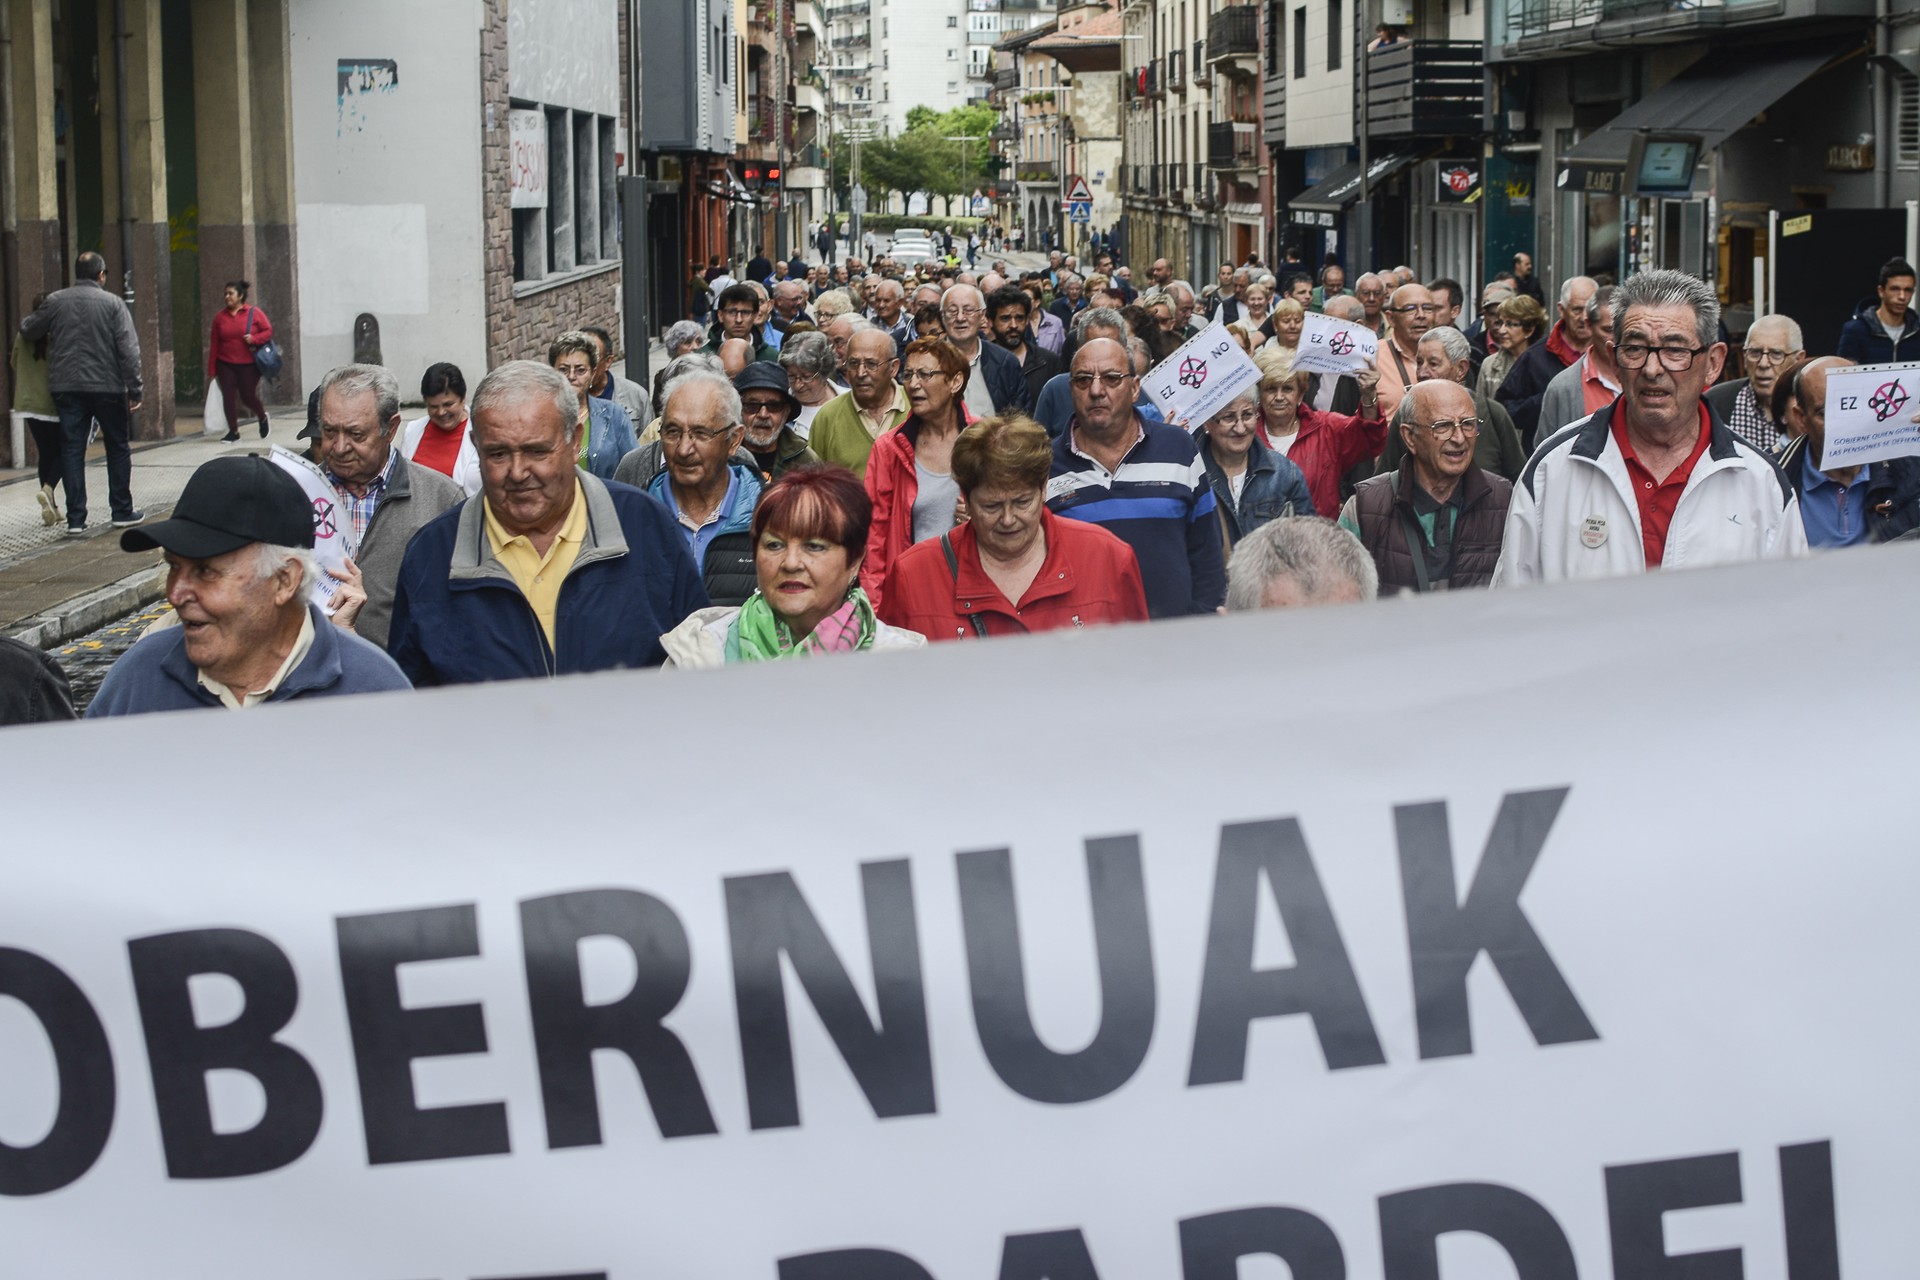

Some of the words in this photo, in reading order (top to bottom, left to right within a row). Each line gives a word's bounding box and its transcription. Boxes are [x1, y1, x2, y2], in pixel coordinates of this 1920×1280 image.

[1311, 333, 1323, 344] EZ
[1210, 341, 1230, 359] NO
[1361, 344, 1375, 355] NO
[1160, 385, 1176, 400] EZ
[1840, 396, 1858, 410] EZ
[1833, 434, 1870, 445] GOBIERNE
[1895, 426, 1916, 435] GOBIE
[1829, 450, 1842, 458] LAS
[1843, 442, 1881, 455] PENSIONES
